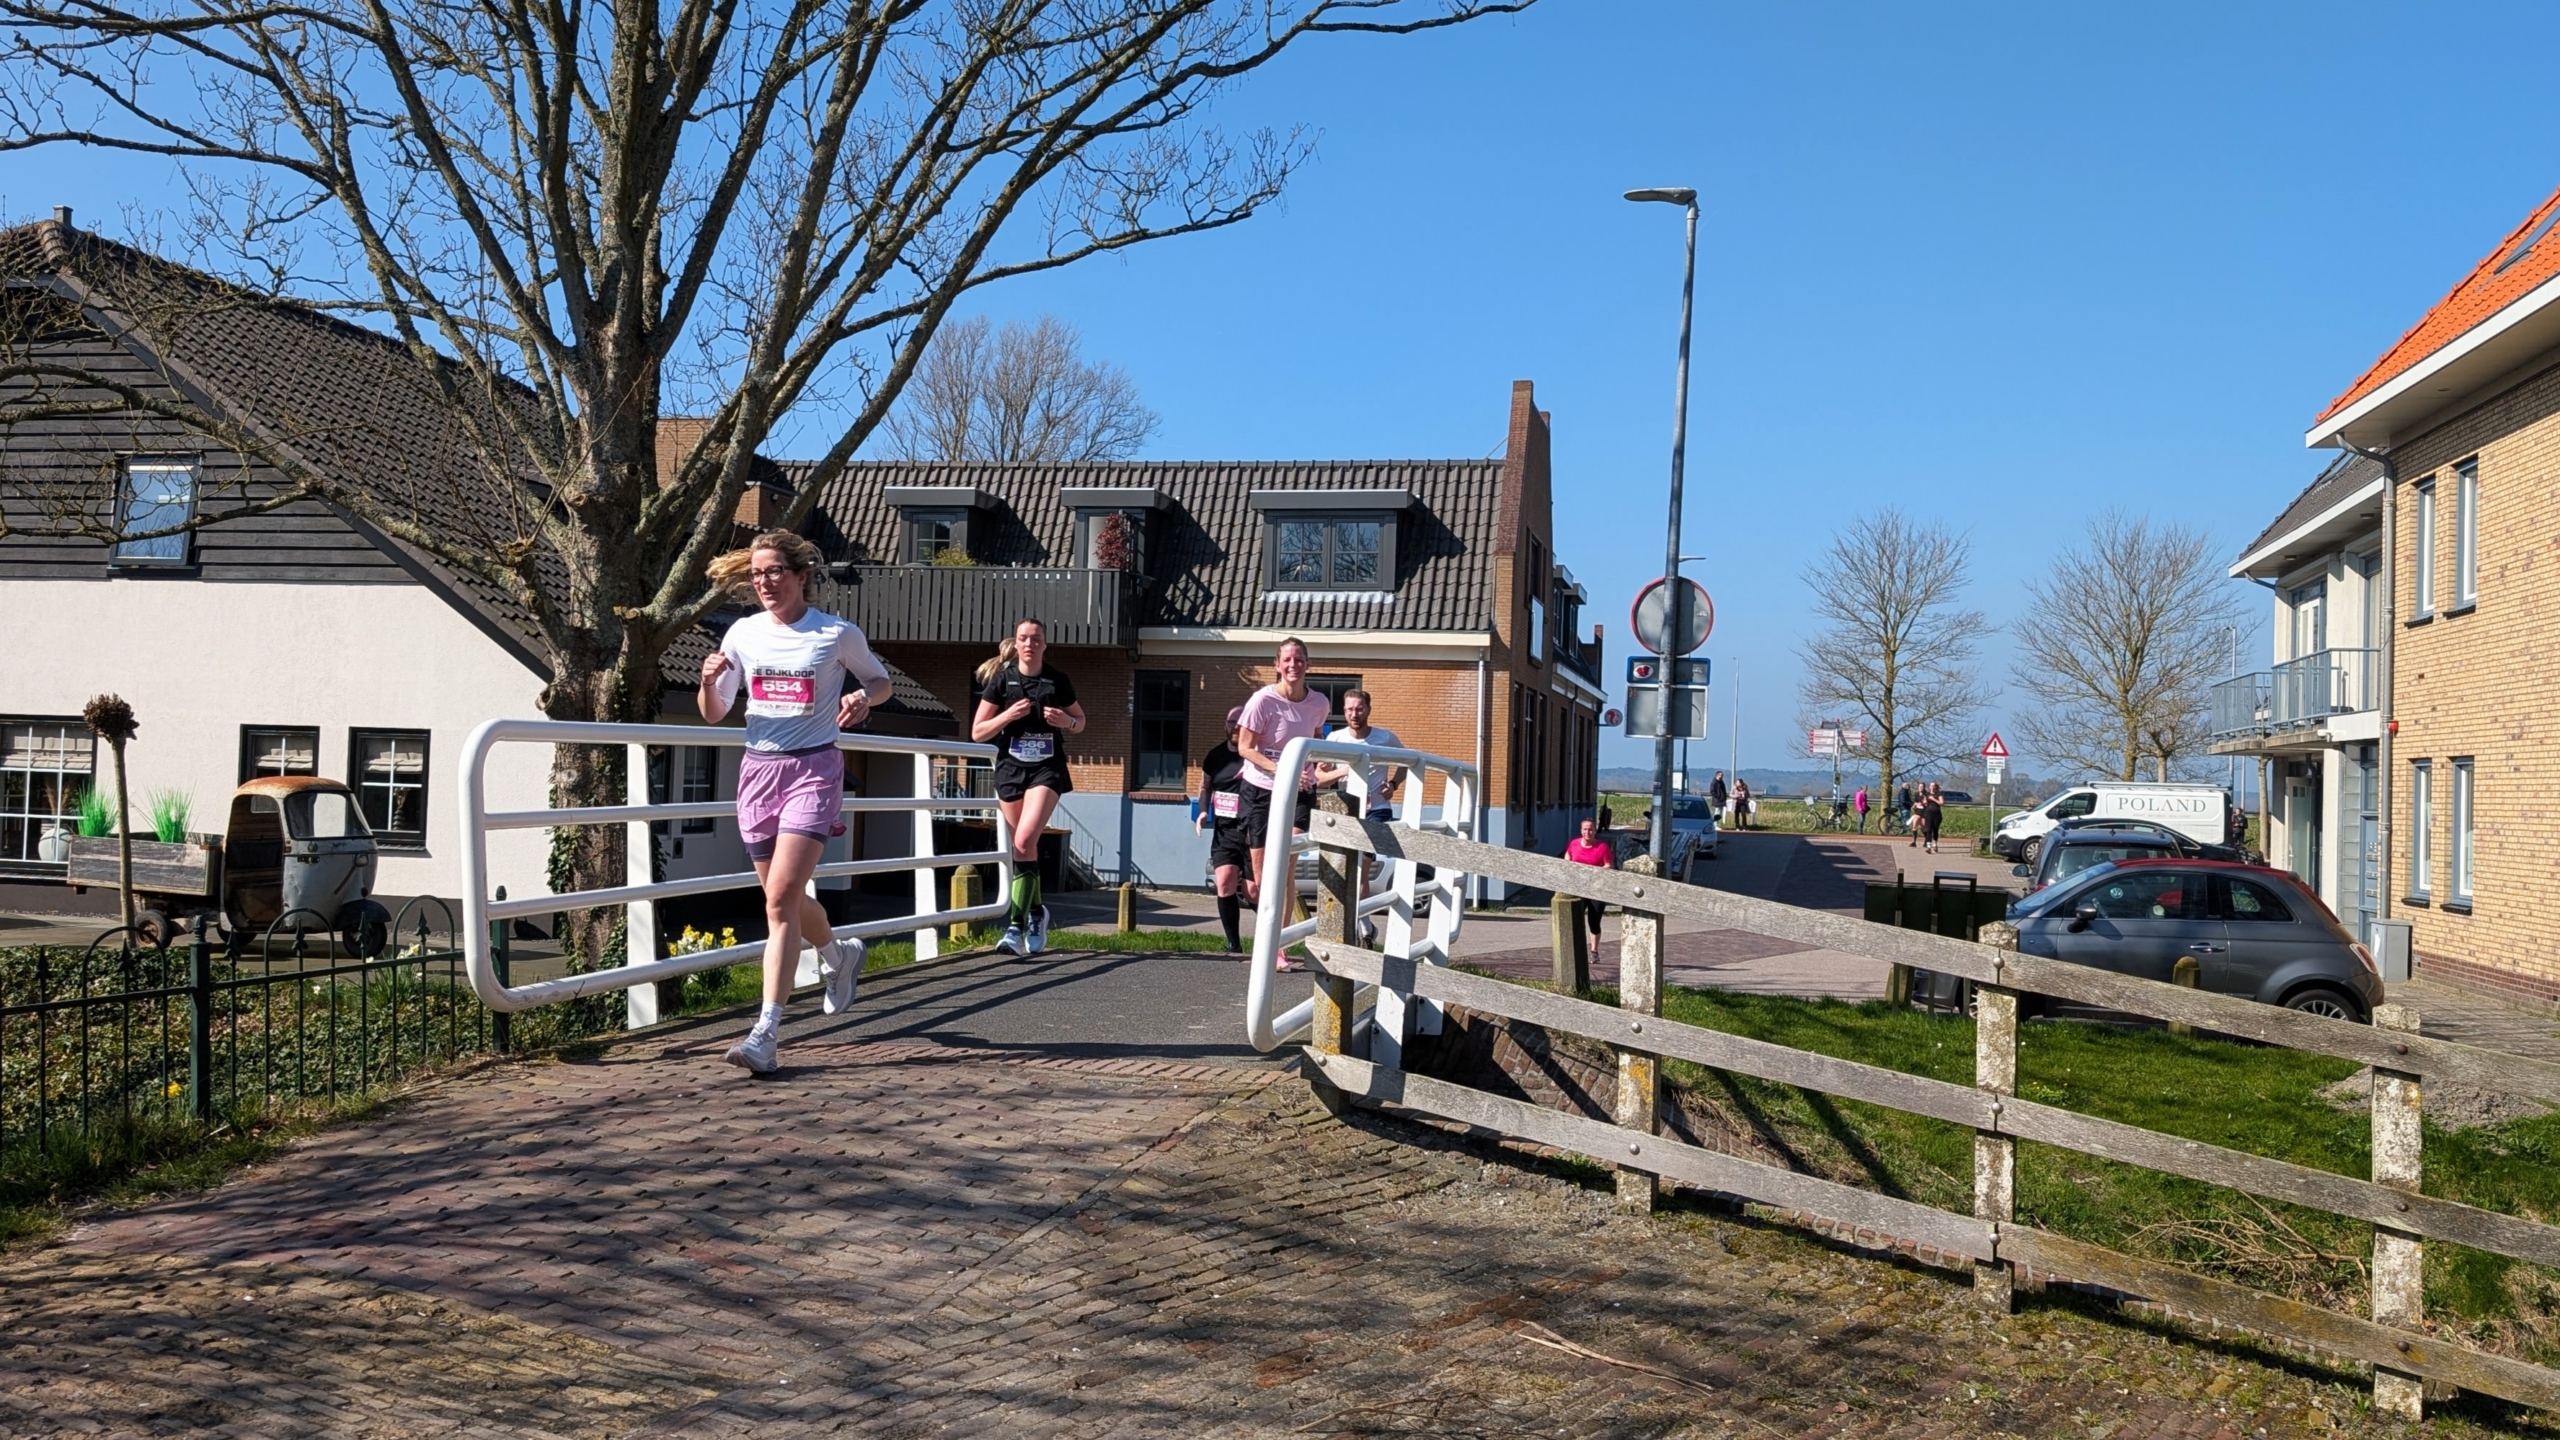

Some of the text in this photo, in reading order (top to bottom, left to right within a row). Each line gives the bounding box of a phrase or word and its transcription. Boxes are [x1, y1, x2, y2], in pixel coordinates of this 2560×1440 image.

[765, 669, 815, 677] DIJKLOOP
[761, 680, 803, 693] 554
[1018, 740, 1046, 749] 366
[2118, 797, 2206, 813] POLAND
